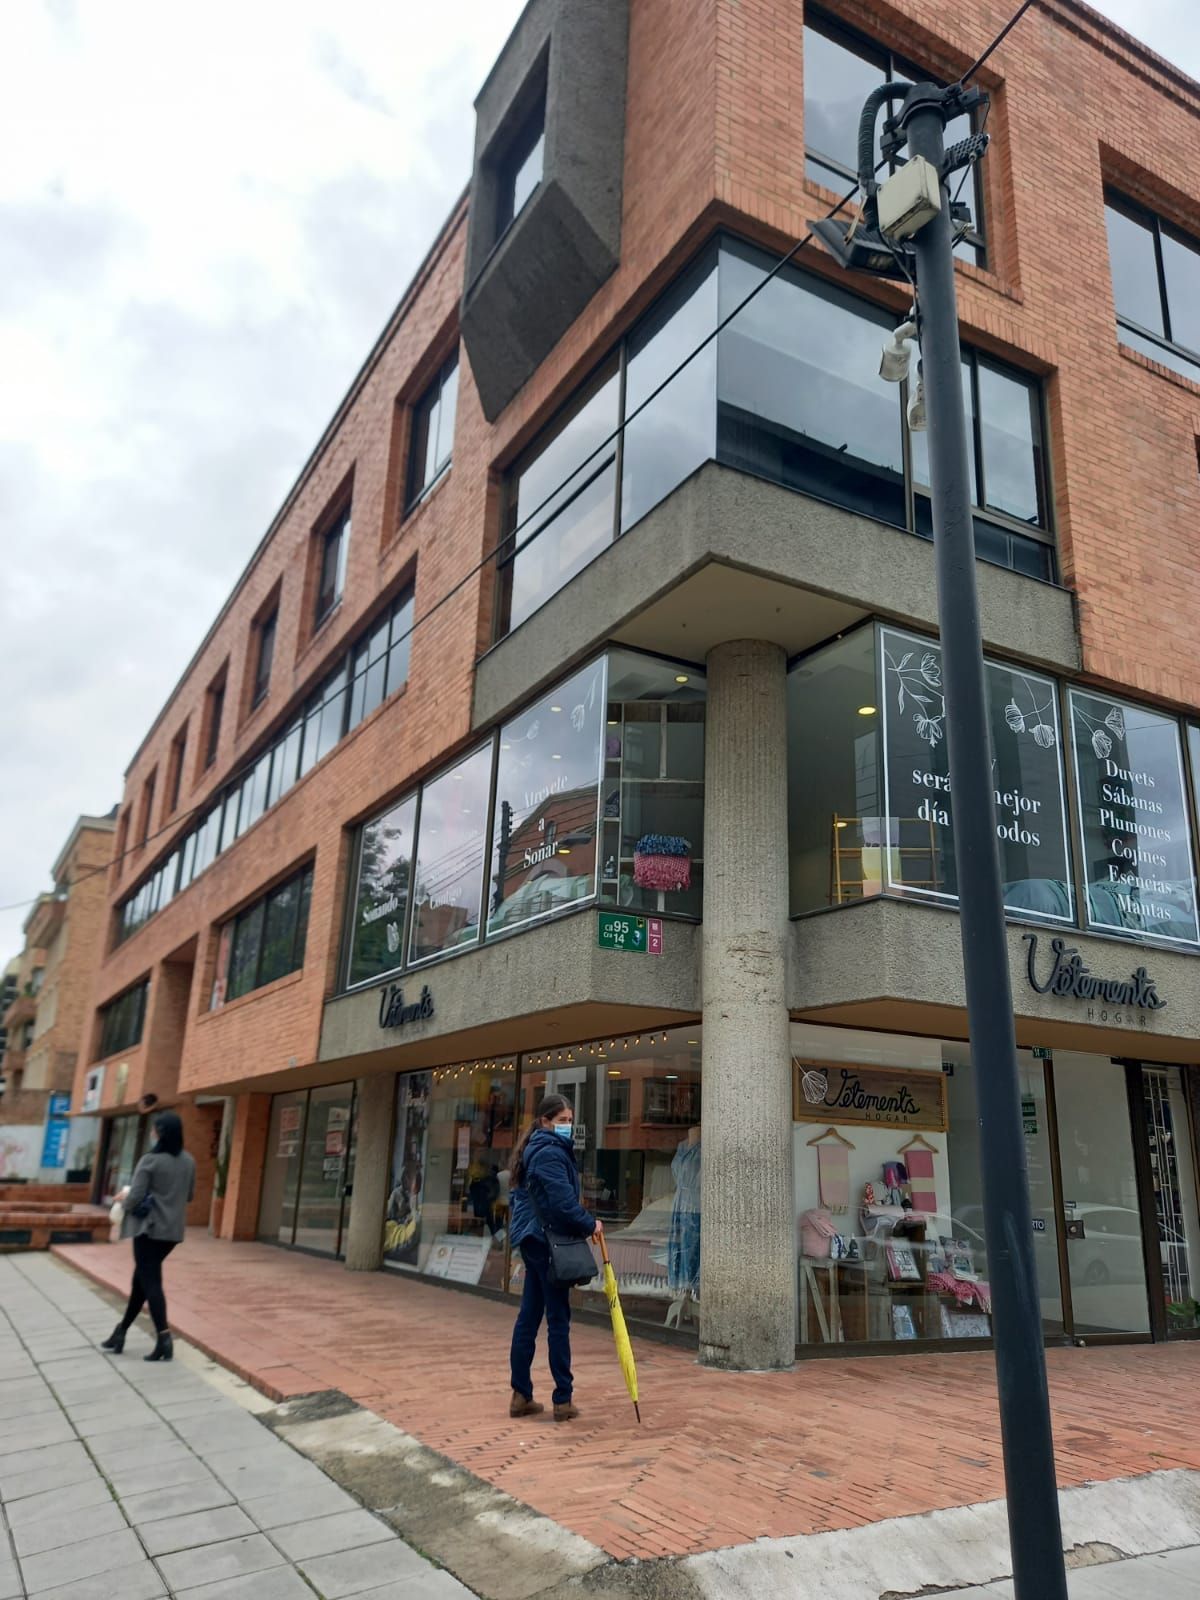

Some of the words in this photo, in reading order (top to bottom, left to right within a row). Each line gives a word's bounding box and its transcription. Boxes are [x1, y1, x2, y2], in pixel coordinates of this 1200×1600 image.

[1104, 759, 1156, 788] Duvets
[1102, 783, 1163, 815] Sábanas
[537, 818, 545, 832] a
[917, 798, 950, 826] día
[996, 820, 1041, 847] odos
[1098, 808, 1171, 841] Plumones
[522, 840, 559, 868] Soñar
[1111, 838, 1167, 867] Cojines
[1107, 863, 1172, 894] Esencias
[1118, 893, 1172, 921] Mantas
[613, 920, 629, 934] 95
[613, 932, 625, 944] 14
[652, 938, 659, 947] 2
[1021, 932, 1168, 1010] Vêtements
[1087, 1007, 1146, 1027] HOGAR
[819, 1068, 921, 1115] Vêtements
[865, 1113, 909, 1124] HOGAR
